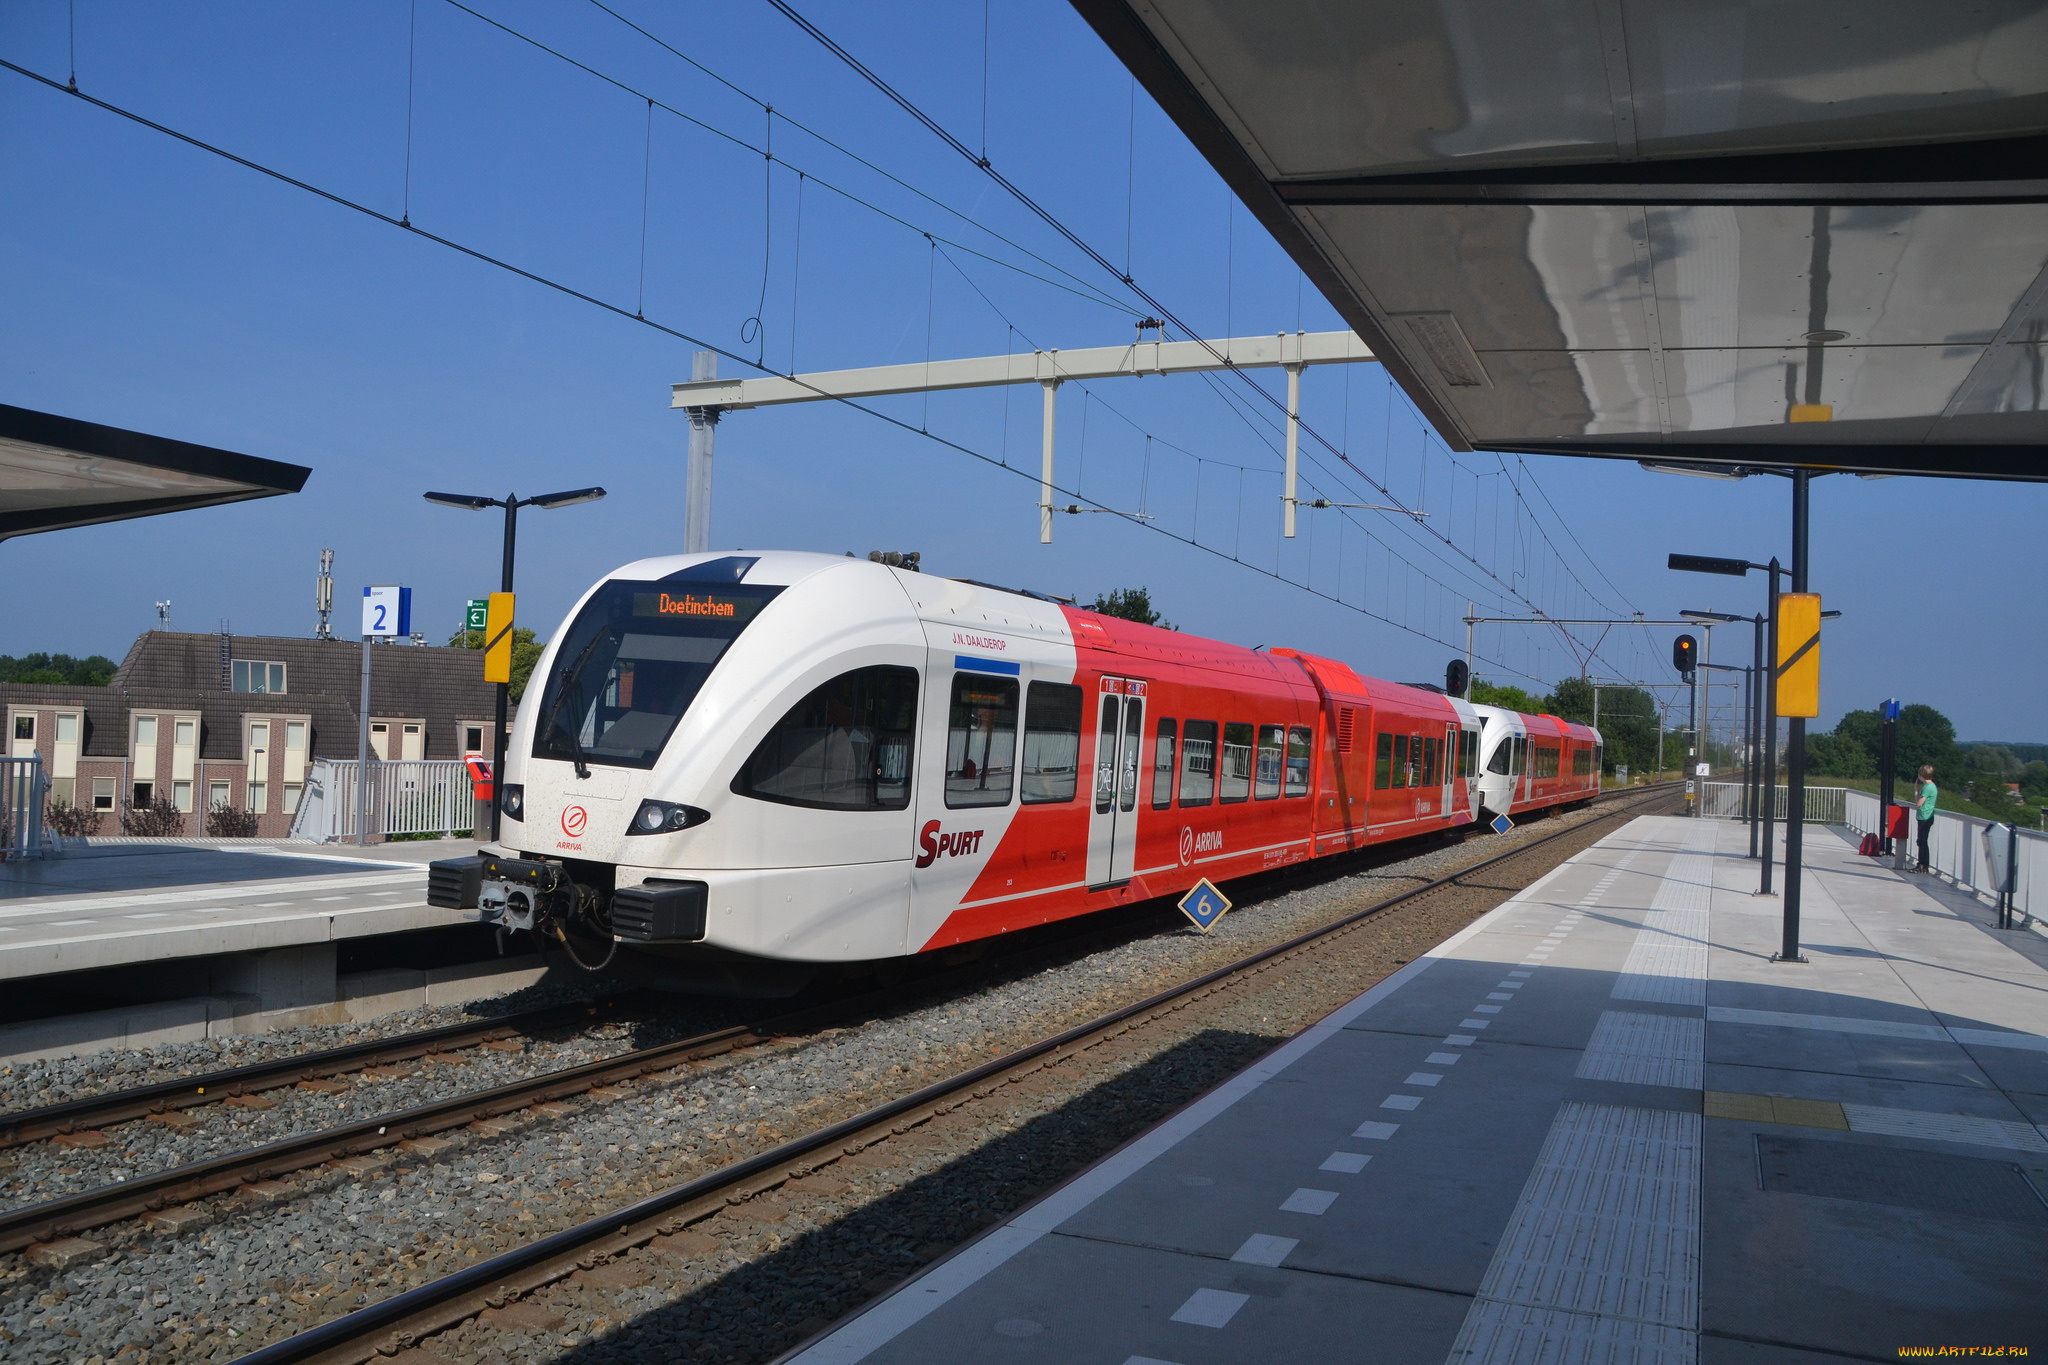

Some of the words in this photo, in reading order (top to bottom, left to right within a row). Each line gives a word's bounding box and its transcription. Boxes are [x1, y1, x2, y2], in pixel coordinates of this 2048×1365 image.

[659, 593, 734, 616] Doetinchem
[373, 604, 387, 631] 2
[952, 632, 965, 645] J.N.
[966, 634, 1007, 651] DAALDEROP
[1687, 782, 1694, 791] P
[555, 841, 582, 851] ARRIVA
[1194, 830, 1223, 854] ARRIVA
[1197, 894, 1212, 916] 6
